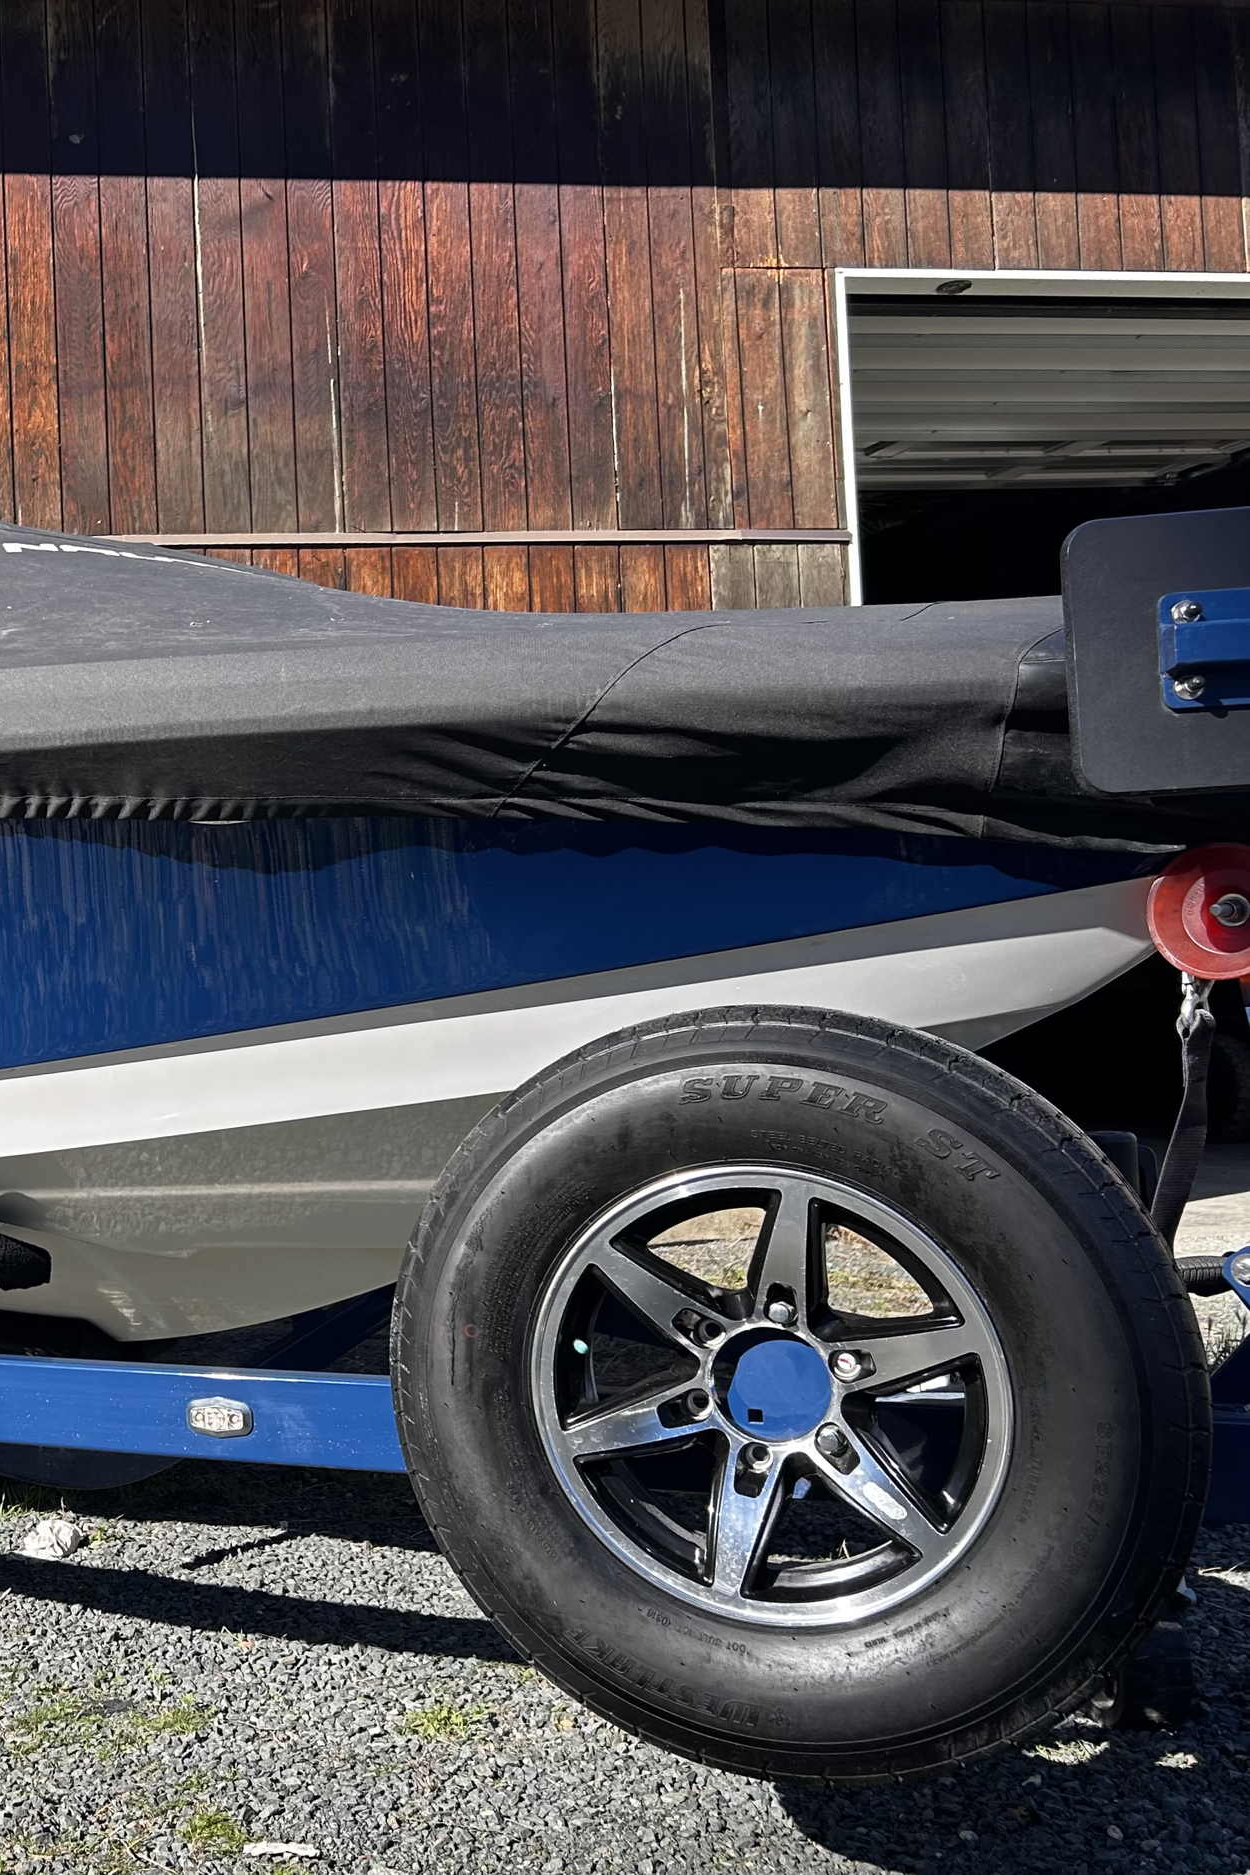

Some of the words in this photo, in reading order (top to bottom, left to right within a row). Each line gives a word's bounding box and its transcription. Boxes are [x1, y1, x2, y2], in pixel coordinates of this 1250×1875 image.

[679, 1074, 889, 1125] SUPER
[913, 1127, 1002, 1182] ST
[750, 1129, 792, 1142] STEEL
[798, 1134, 848, 1155] BELTED
[853, 1150, 902, 1180] RADIAL
[563, 1622, 762, 1730] WESTLAKE
[725, 1642, 746, 1656] DOT
